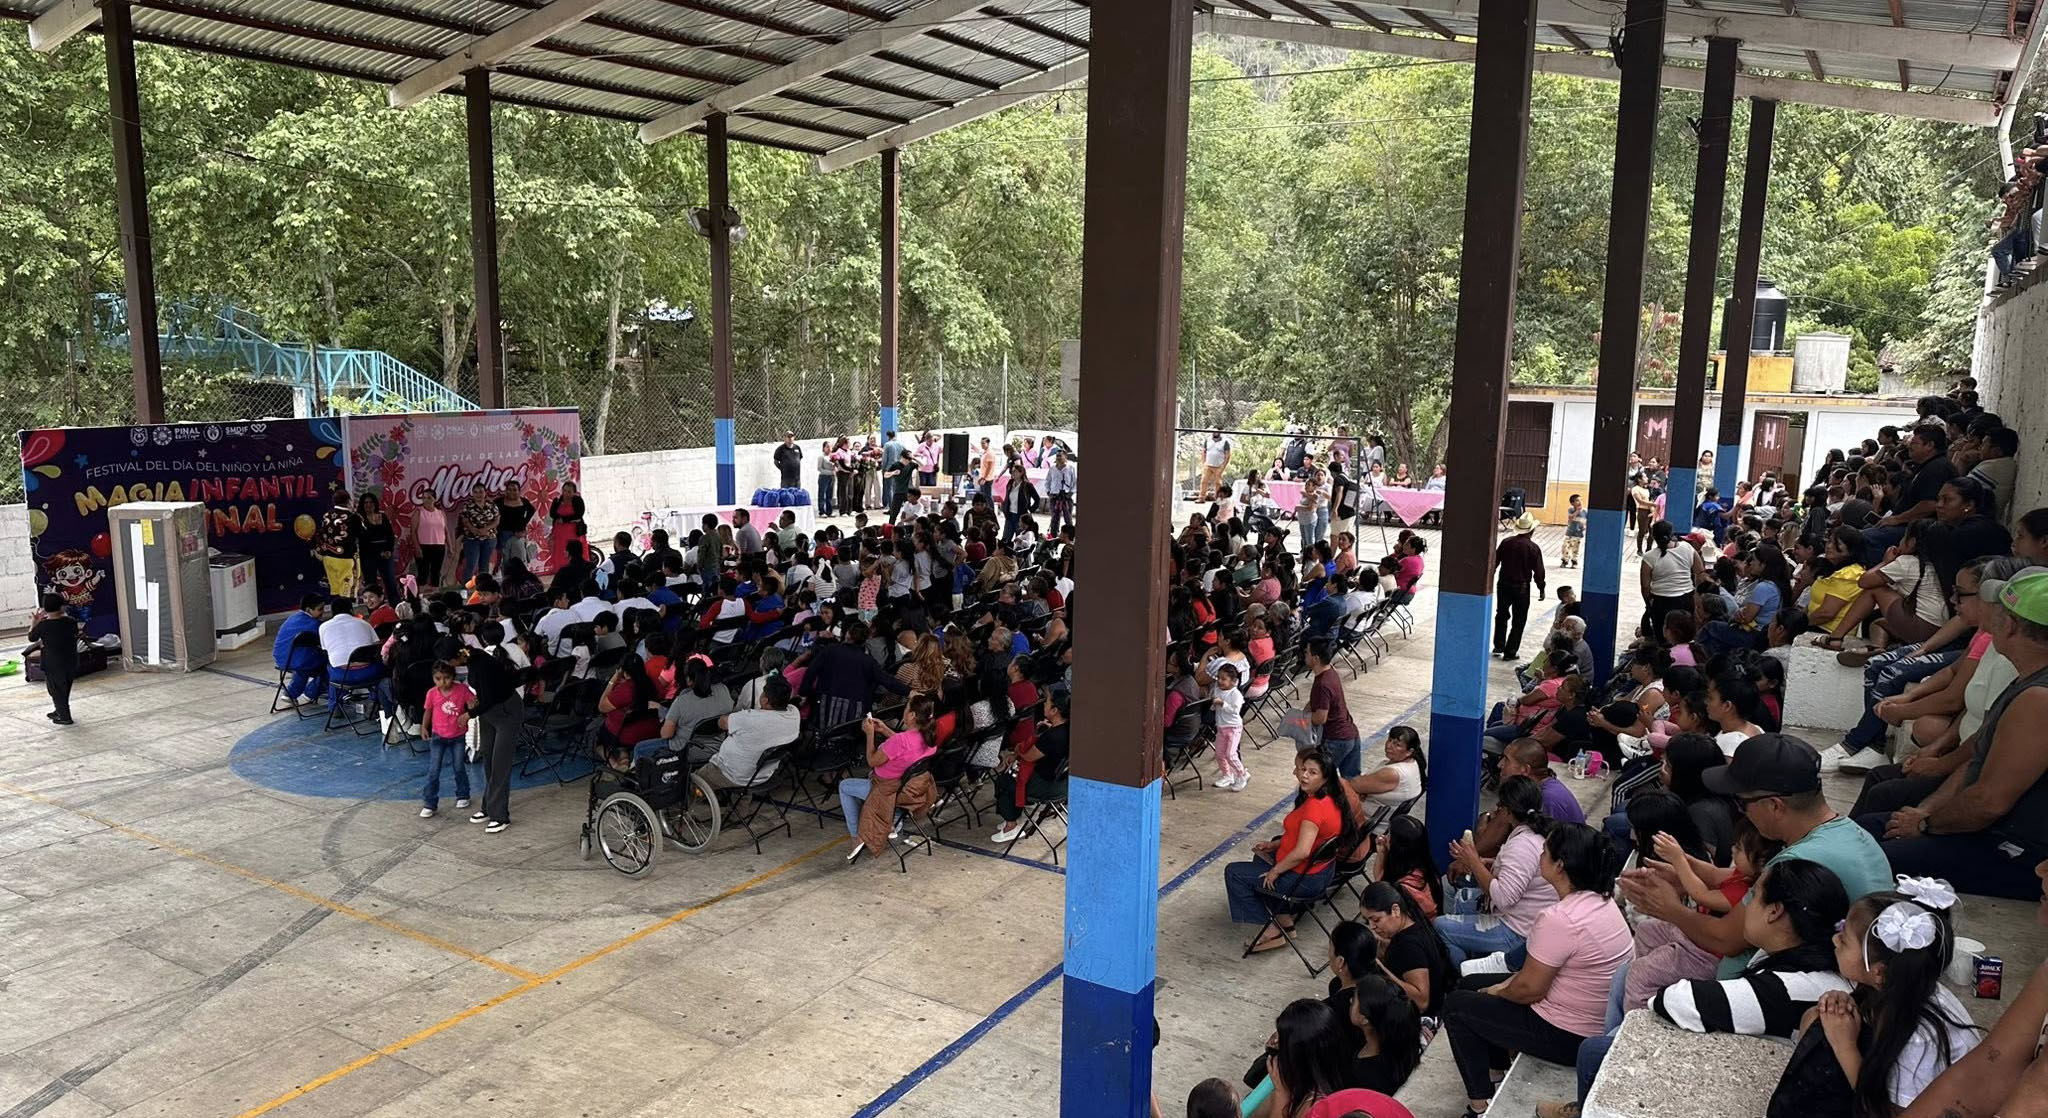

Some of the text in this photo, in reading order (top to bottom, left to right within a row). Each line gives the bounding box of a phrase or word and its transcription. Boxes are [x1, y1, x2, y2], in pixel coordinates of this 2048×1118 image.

[174, 427, 200, 435] PINAL
[1647, 417, 1668, 440] M
[1764, 421, 1777, 450] H
[86, 456, 304, 479] FESTIVAL DEL DÍA DEL NIÑO Y LA NIÑA
[409, 455, 446, 464] FELIZ
[479, 451, 493, 460] DE
[499, 450, 519, 459] LAS
[74, 475, 319, 517] MAGIA INFANTIL
[410, 460, 528, 509] Madres
[204, 503, 283, 536] INAL
